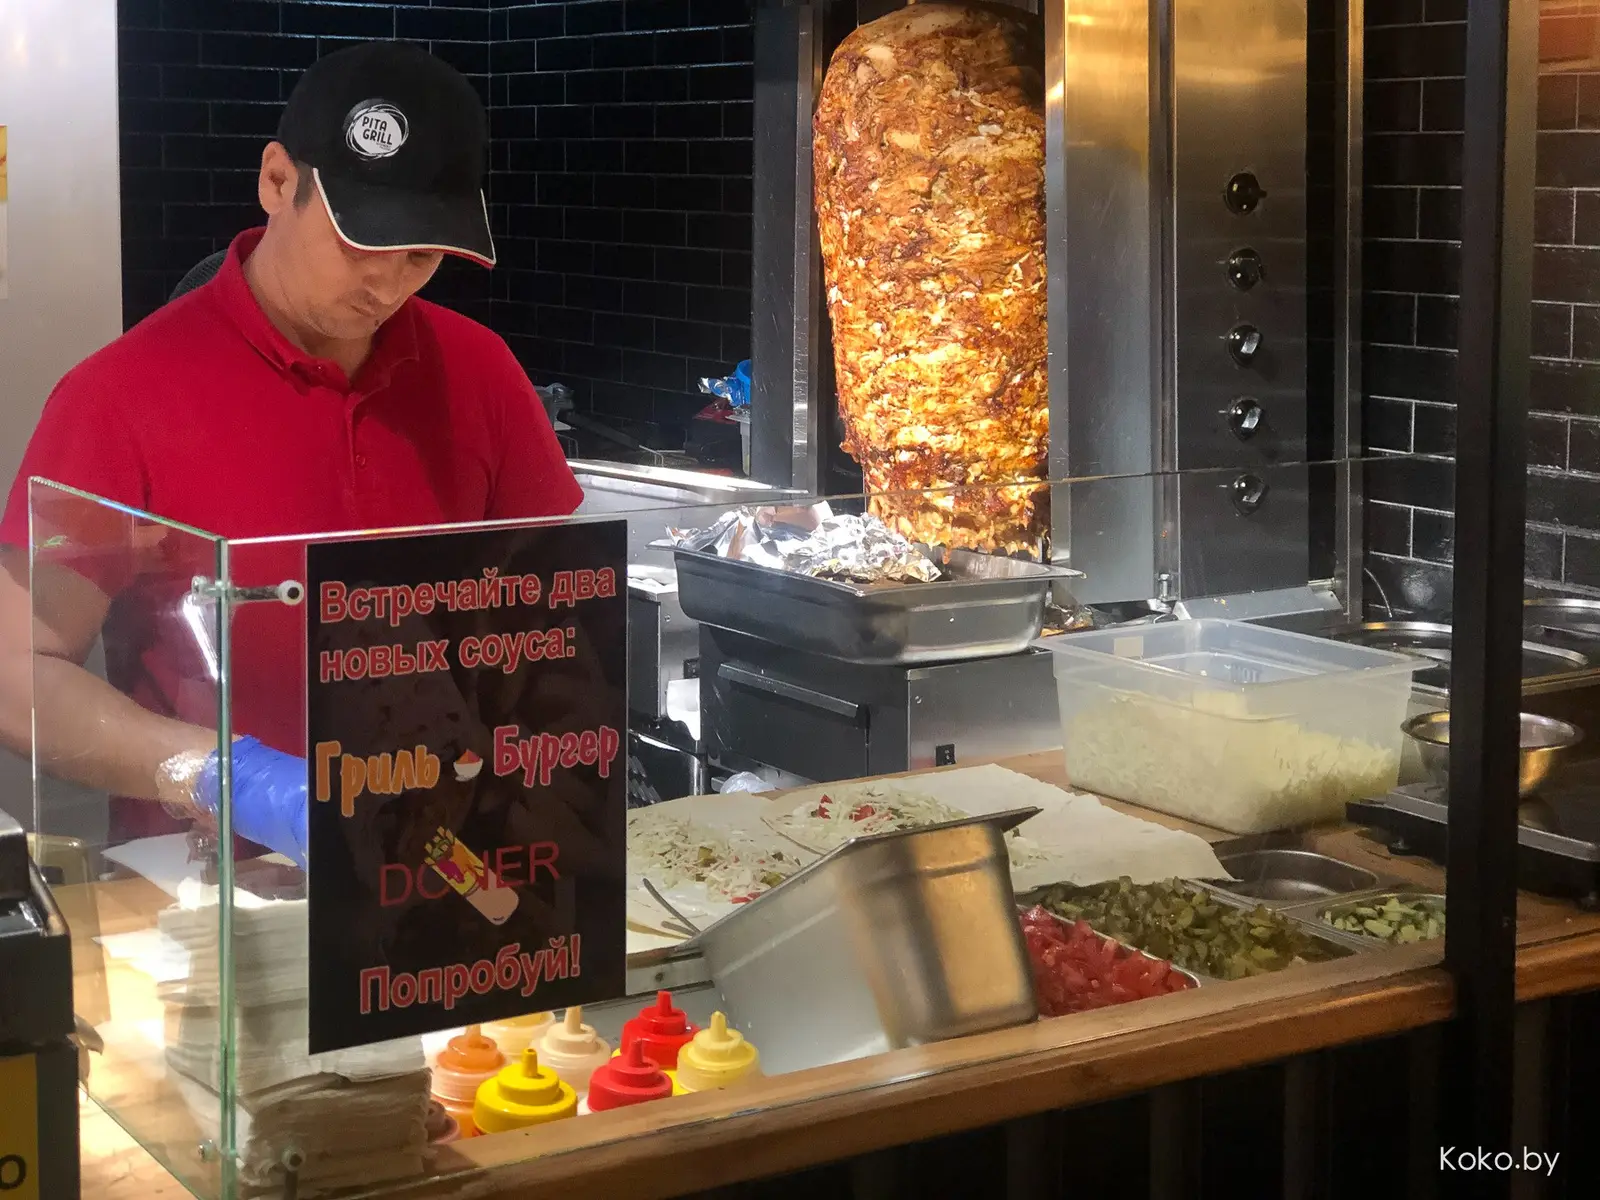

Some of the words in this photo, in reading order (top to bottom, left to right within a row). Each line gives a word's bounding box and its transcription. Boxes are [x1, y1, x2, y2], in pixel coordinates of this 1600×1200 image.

[361, 116, 388, 131] PITA
[362, 128, 393, 146] GRILL
[320, 567, 541, 627] Встречайте
[549, 567, 616, 609] два
[320, 640, 449, 683] новых
[459, 627, 576, 674] соуса:
[315, 741, 441, 818] Гриль
[494, 725, 619, 788] Бургер
[359, 934, 581, 1015] Попробуй!
